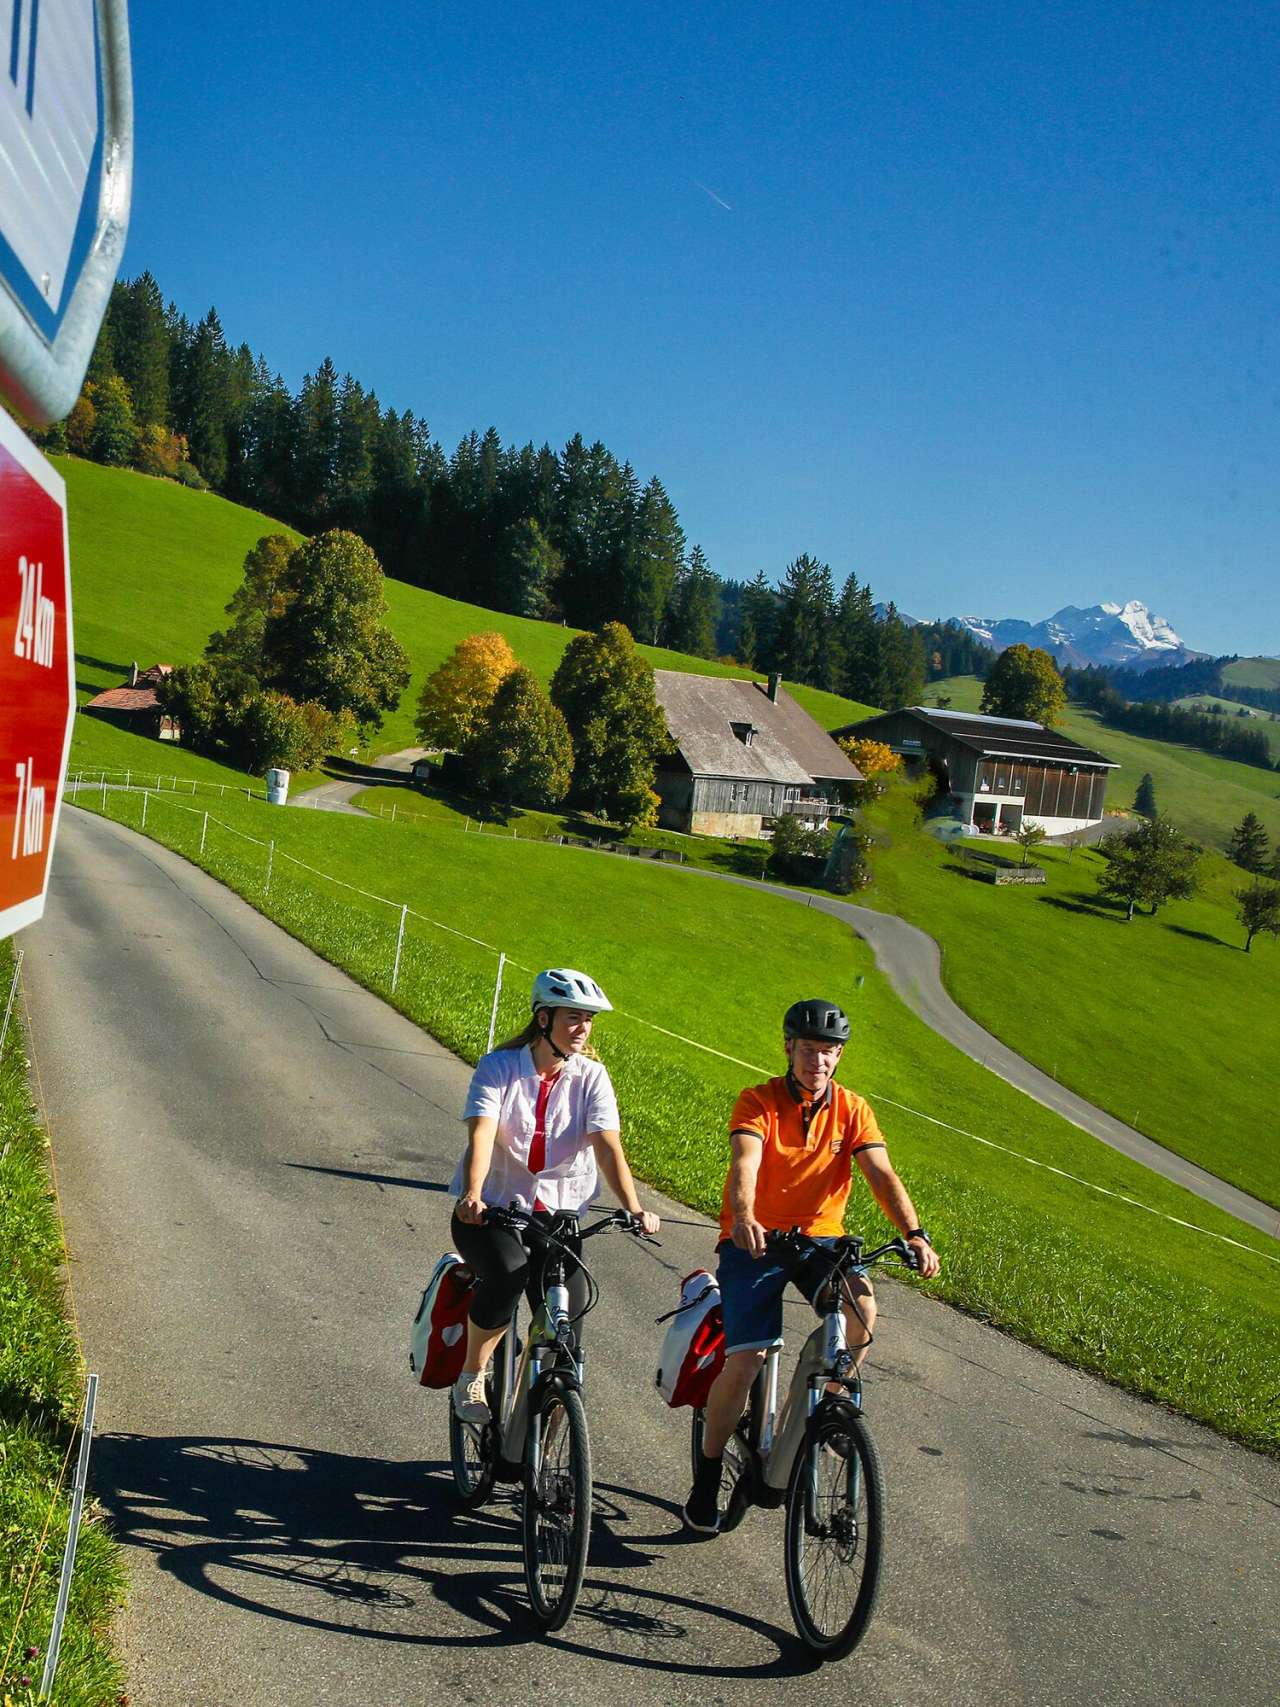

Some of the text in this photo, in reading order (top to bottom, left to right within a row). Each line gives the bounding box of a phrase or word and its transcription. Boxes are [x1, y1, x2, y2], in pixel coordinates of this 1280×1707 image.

[14, 555, 55, 669] 24 km
[22, 757, 45, 857] km
